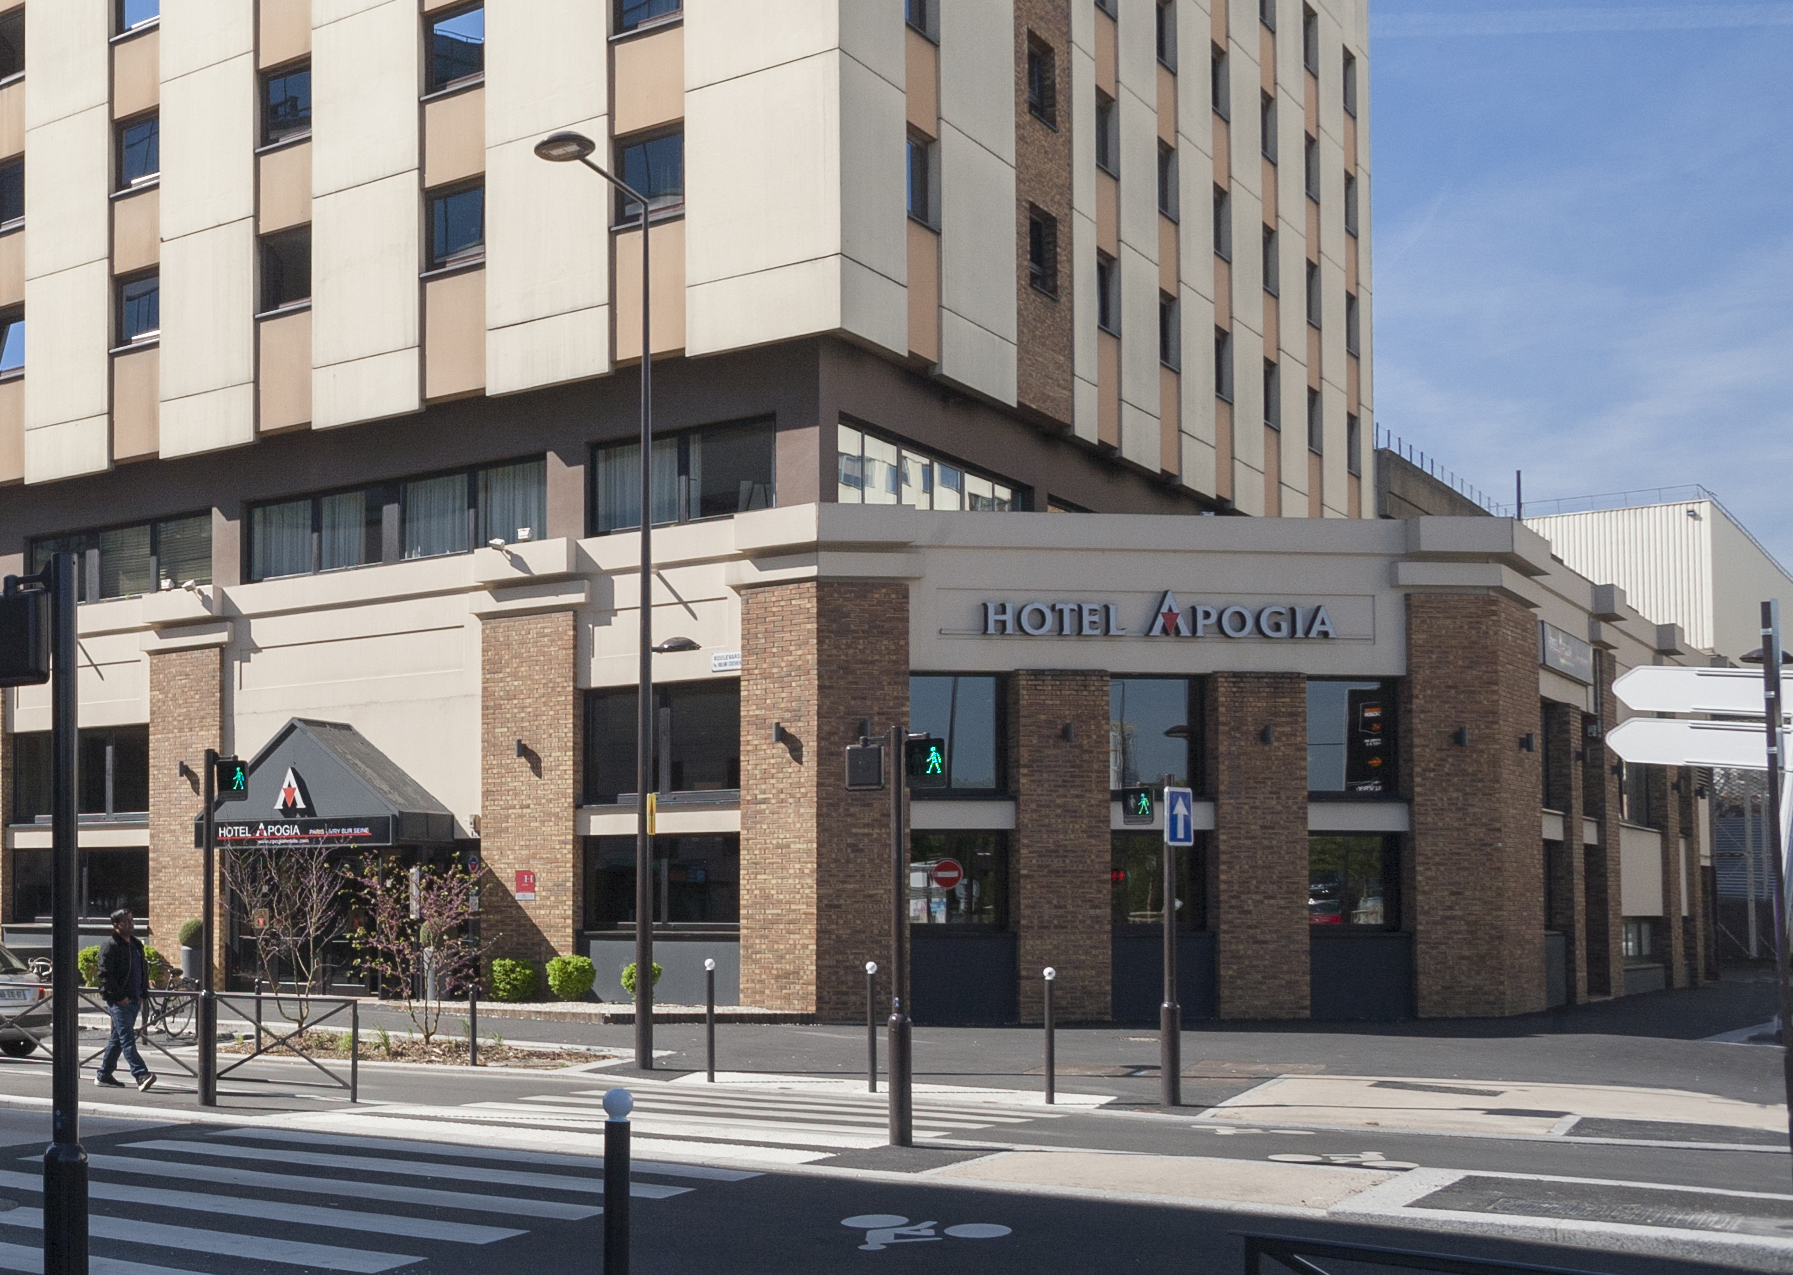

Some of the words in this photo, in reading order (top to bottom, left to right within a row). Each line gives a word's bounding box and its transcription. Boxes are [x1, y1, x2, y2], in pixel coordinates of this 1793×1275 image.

[982, 602, 1127, 636] HOTEL
[1144, 589, 1337, 639] APOGIA
[218, 825, 251, 837] HOTEL
[255, 822, 300, 837] APOGIA
